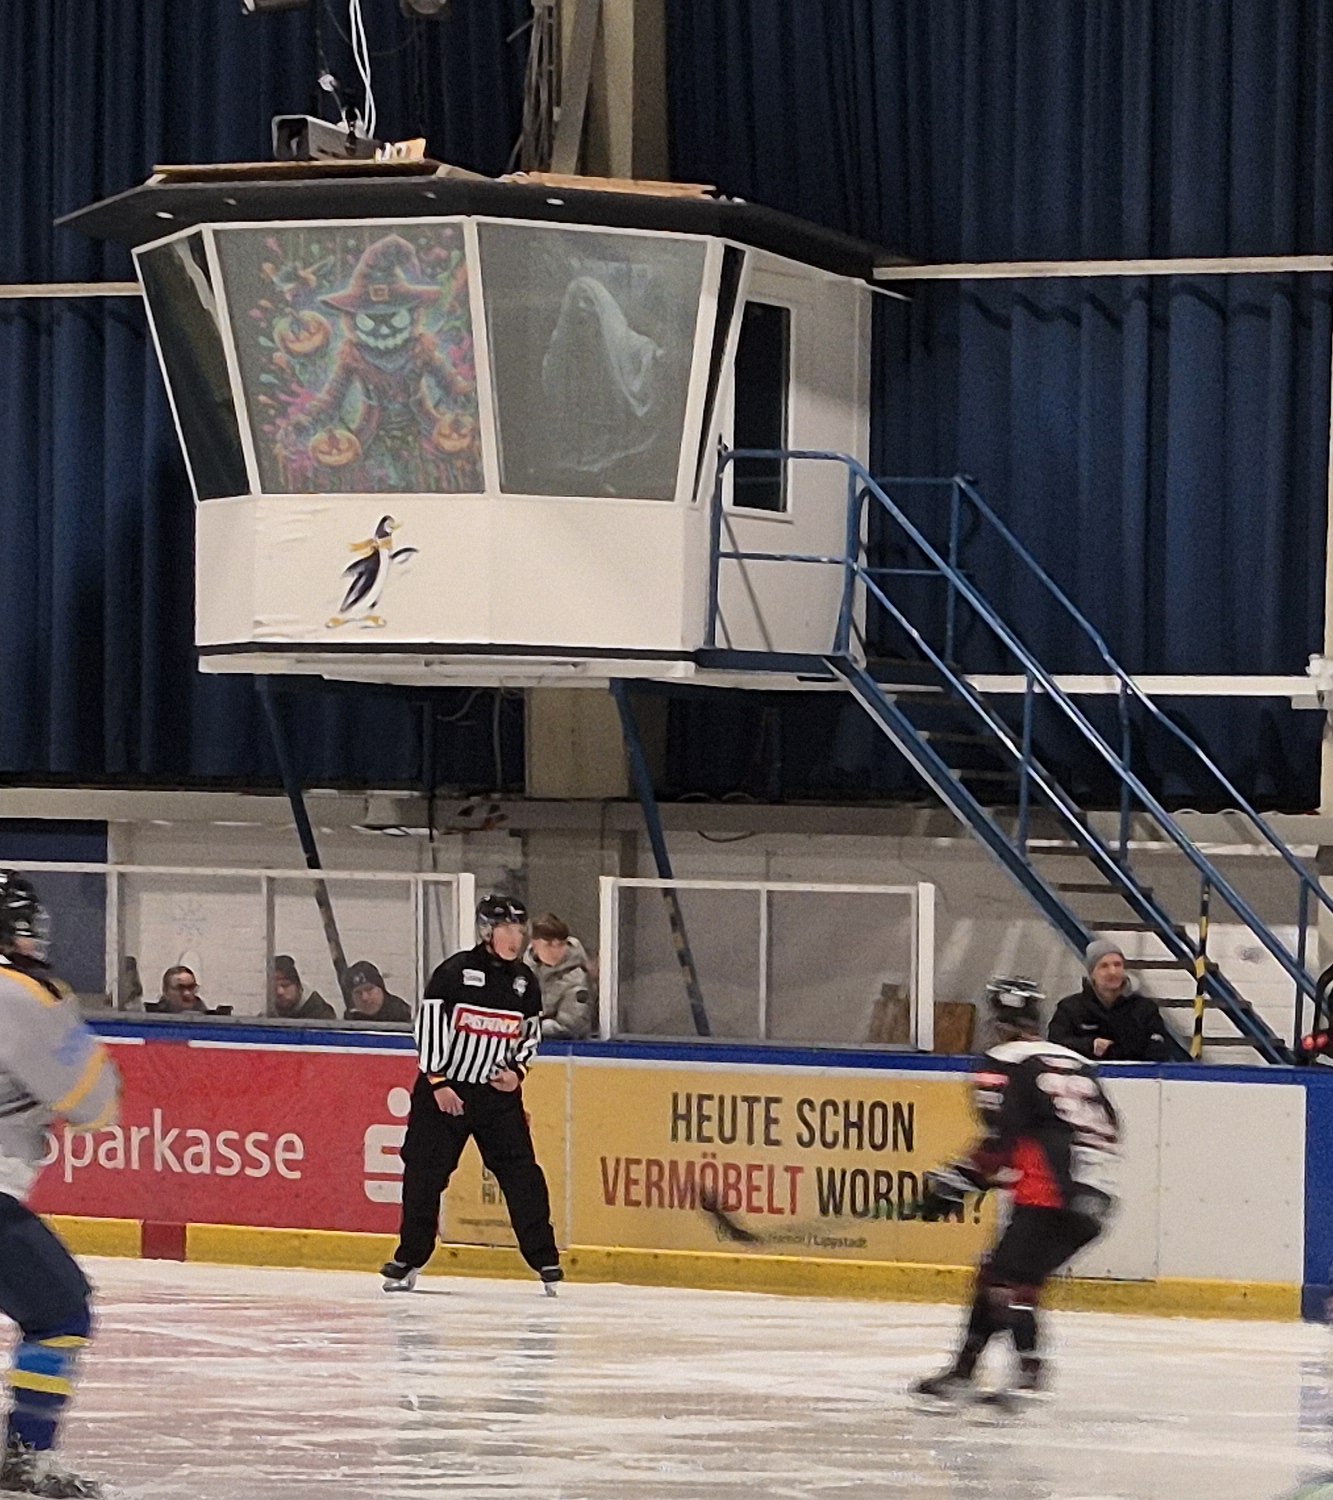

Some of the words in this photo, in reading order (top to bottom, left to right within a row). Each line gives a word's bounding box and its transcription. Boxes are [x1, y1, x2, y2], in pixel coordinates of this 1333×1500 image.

[671, 1092, 783, 1146] HEUTE
[796, 1097, 914, 1152] SCHON
[600, 1151, 804, 1216] VERMÖBELT
